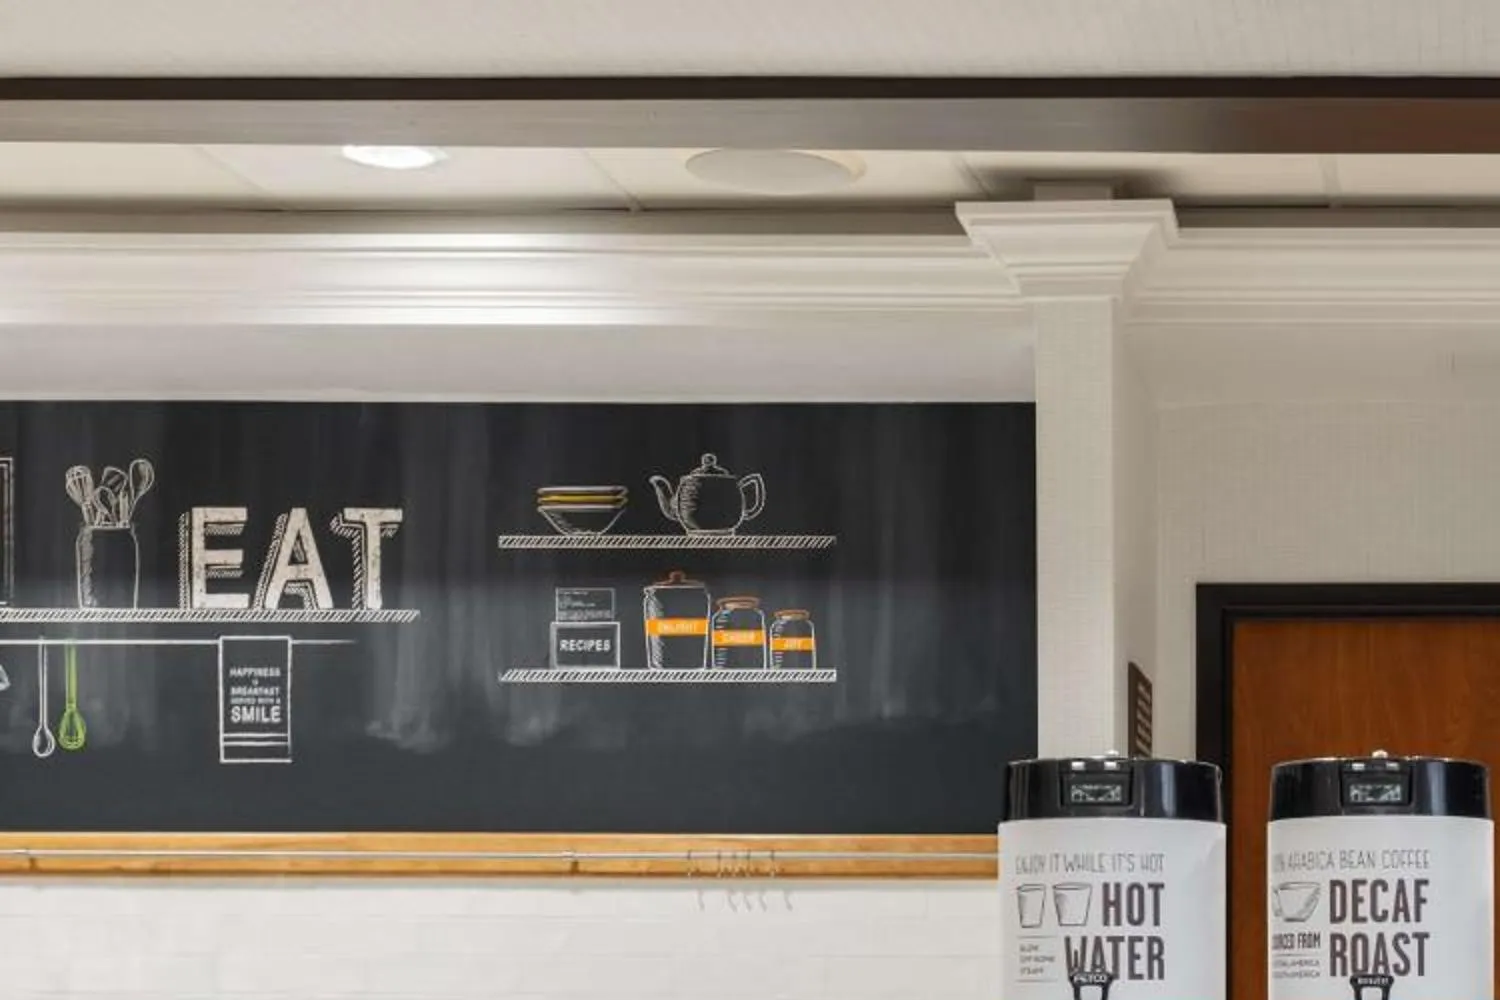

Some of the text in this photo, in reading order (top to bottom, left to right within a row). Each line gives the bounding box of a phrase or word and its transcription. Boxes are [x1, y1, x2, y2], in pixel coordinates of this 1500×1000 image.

[180, 507, 403, 610] EAT
[560, 639, 611, 652] RECIPES
[231, 706, 281, 723] SMILE
[1049, 853, 1060, 872] IT
[1063, 852, 1106, 873] WHILE
[1140, 853, 1165, 872] HOT
[1287, 851, 1335, 871] ARABICA
[1339, 850, 1375, 870] BEAN
[1381, 850, 1430, 869] COFFEE
[1102, 882, 1165, 927] HOT
[1329, 878, 1429, 924] DECAF
[1297, 932, 1321, 949] FROM
[1329, 932, 1430, 977] ROAST
[1064, 935, 1165, 981] WATER
